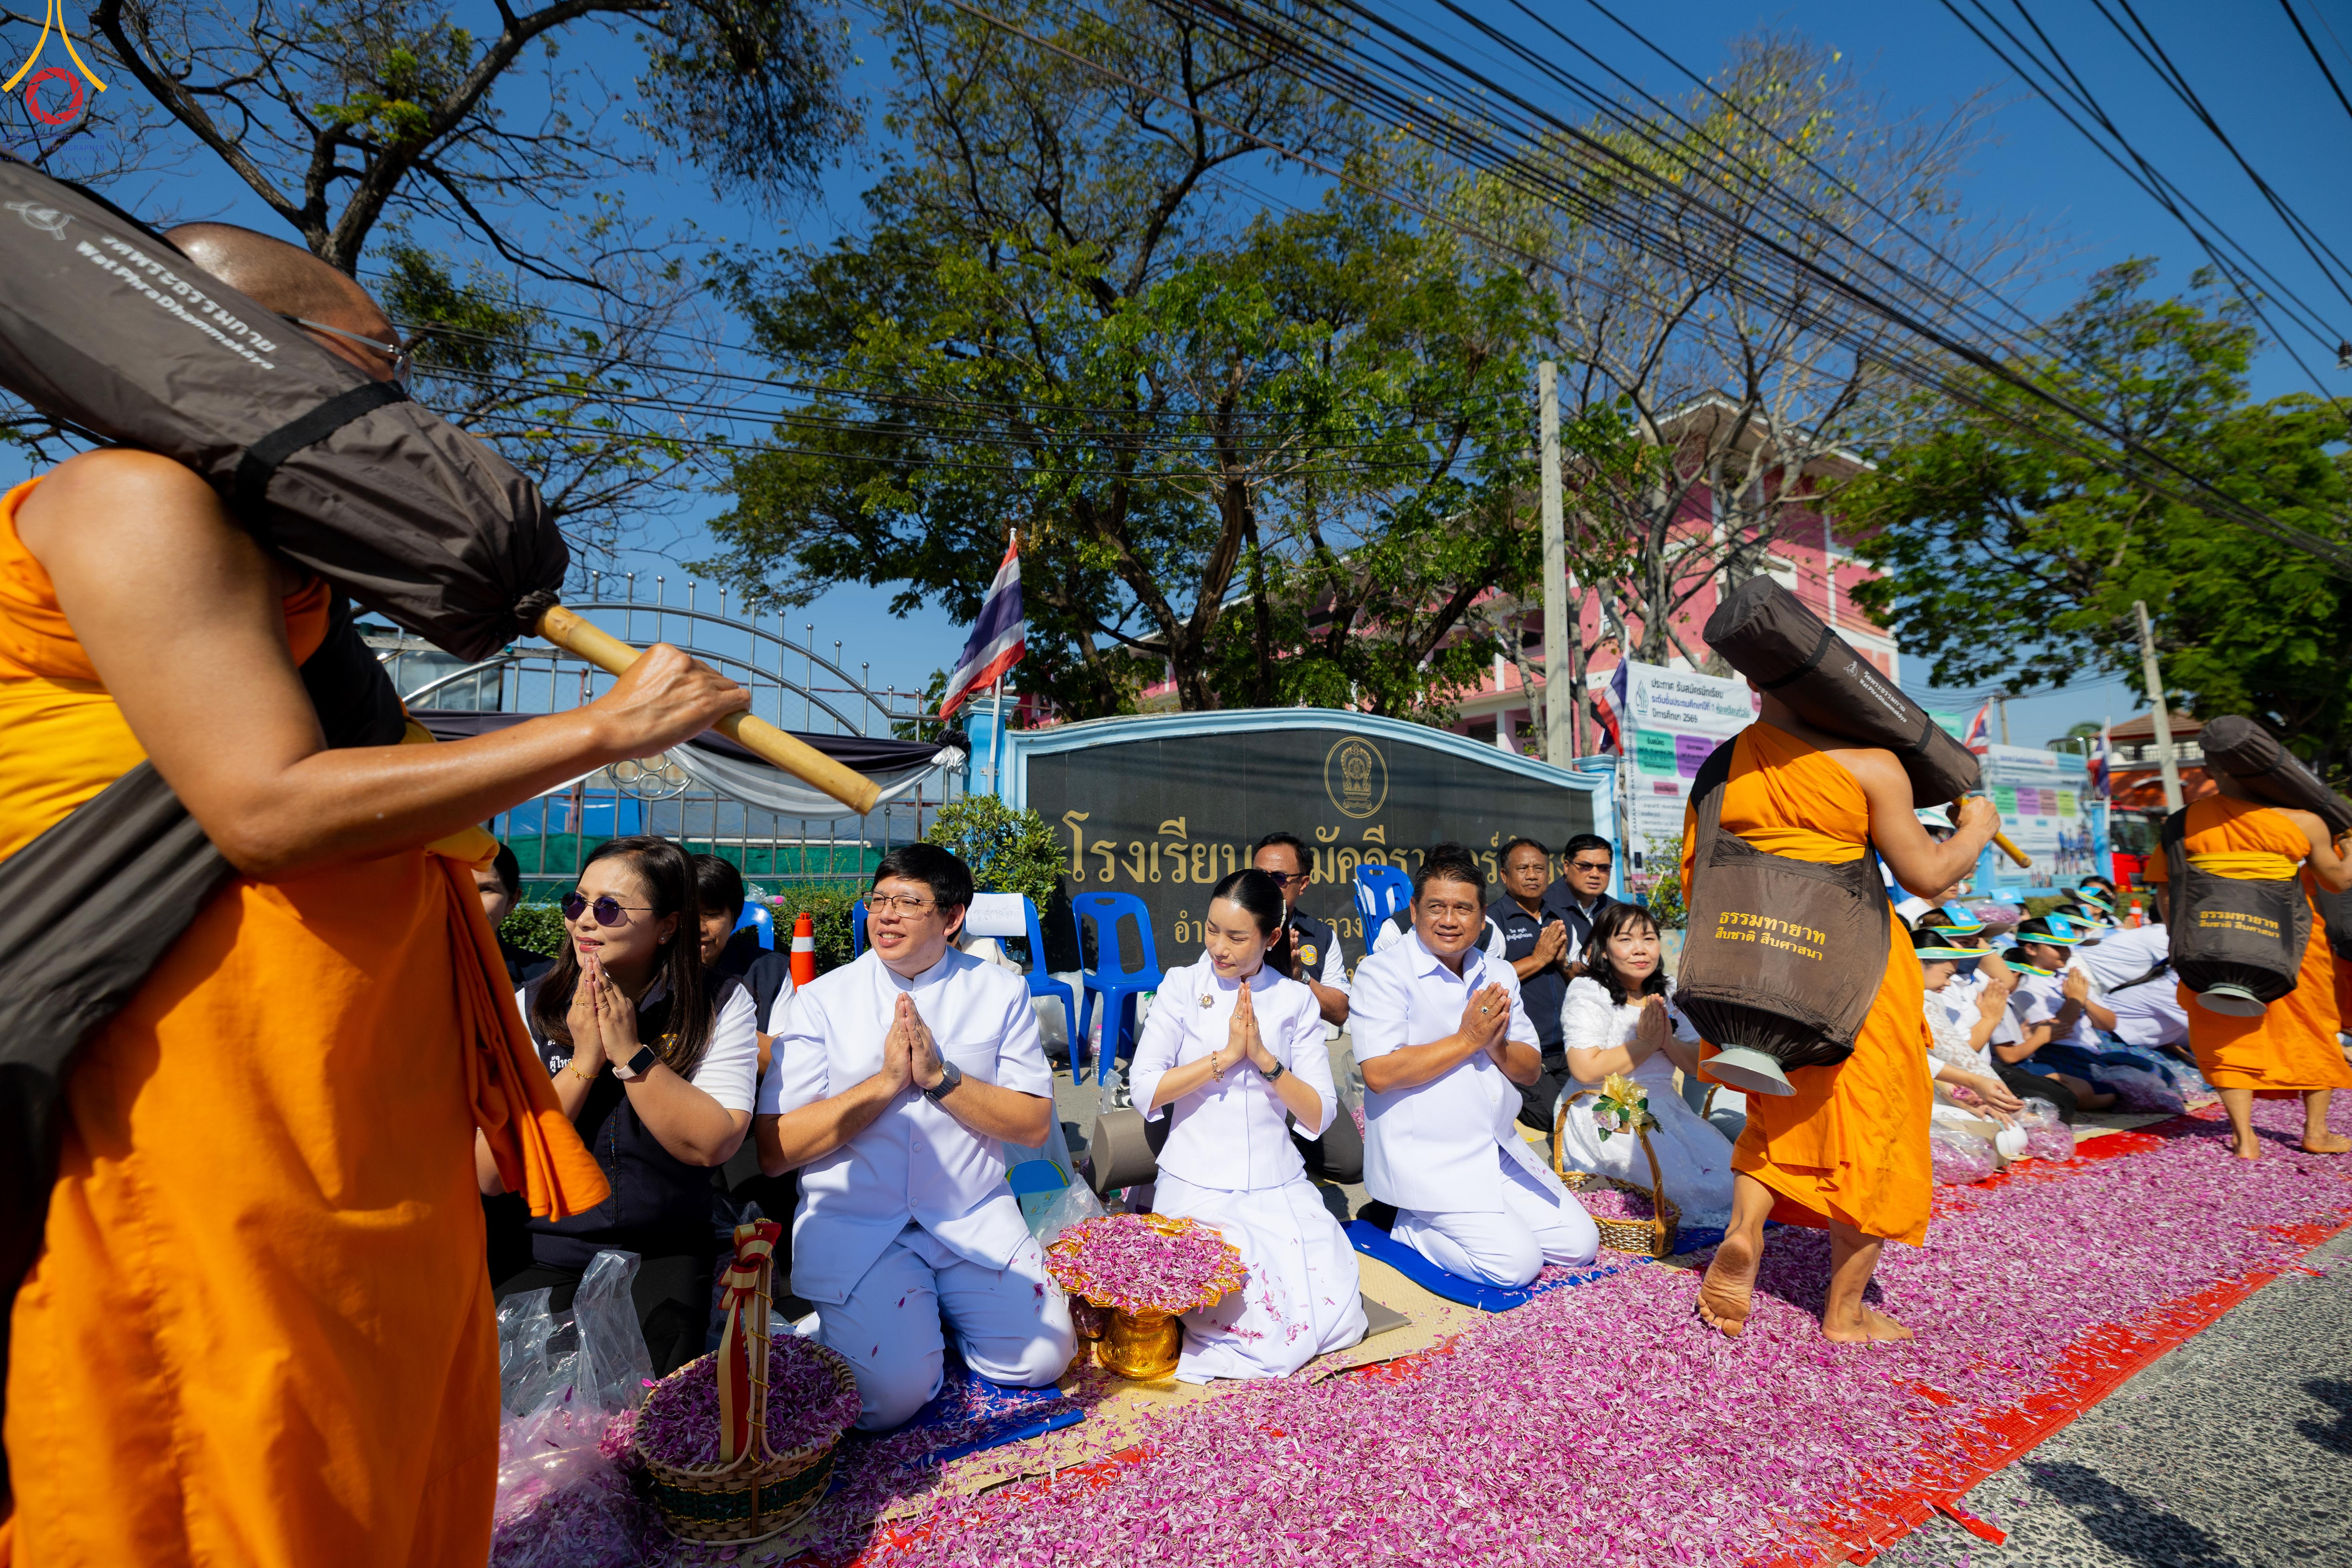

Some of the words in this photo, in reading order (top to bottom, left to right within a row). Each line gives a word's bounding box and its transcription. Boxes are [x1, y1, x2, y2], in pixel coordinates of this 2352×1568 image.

[75, 240, 118, 270] Wat
[1651, 677, 1674, 690] ประกาศ
[1864, 671, 1906, 712] วัดพระธรรมกาย
[1719, 912, 1825, 945] ธรรมทายาท
[2199, 911, 2279, 929] ธรรมทายาท
[1715, 927, 1756, 942] สืบชาติ
[1760, 932, 1823, 961] สืบศาสนา
